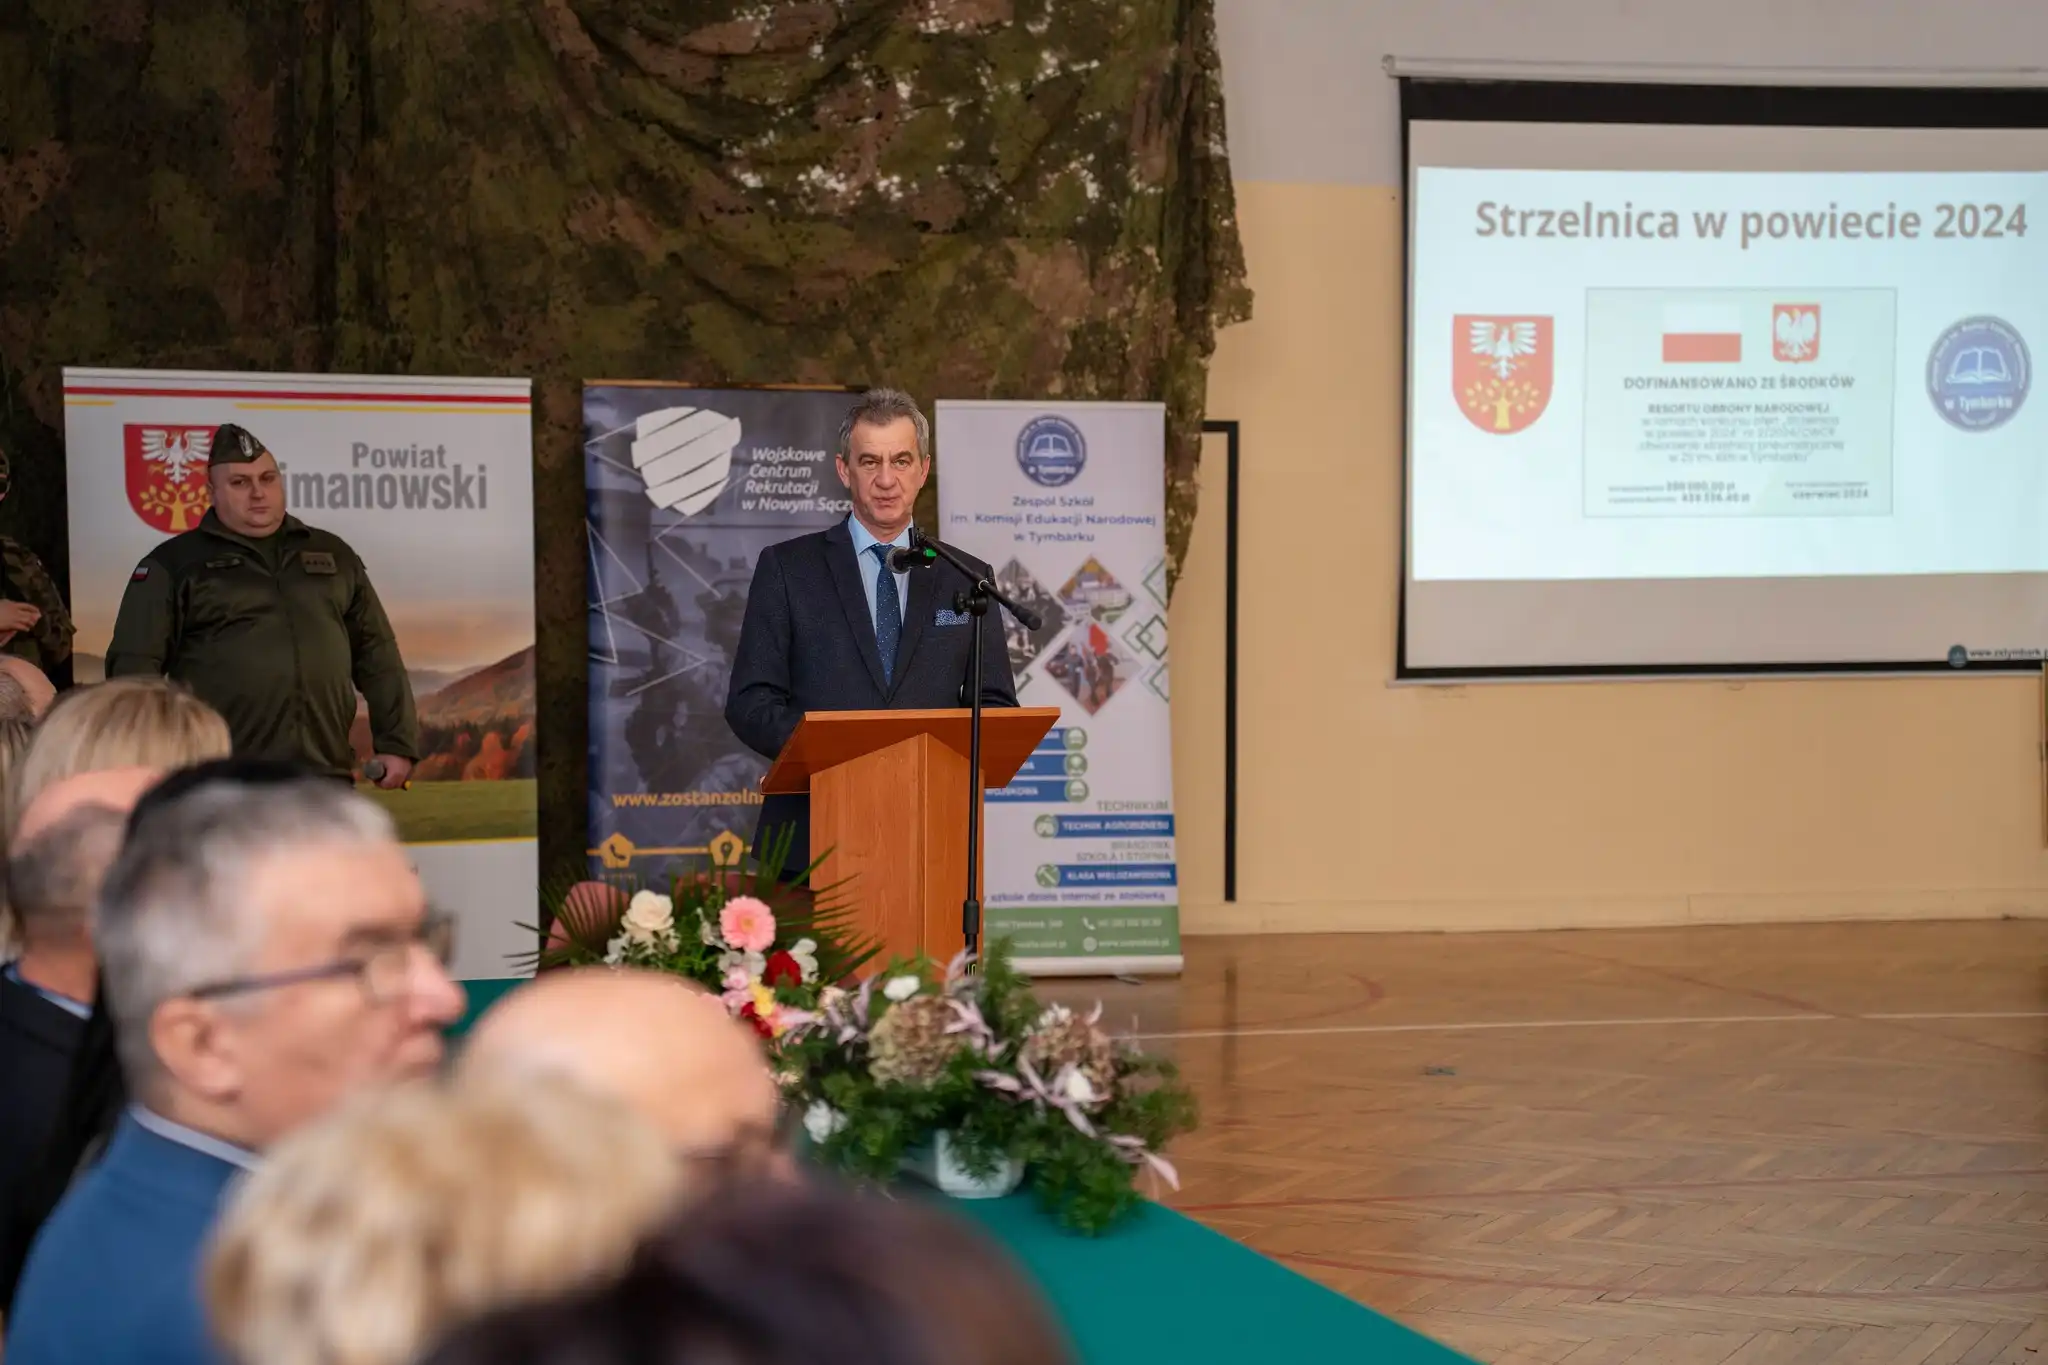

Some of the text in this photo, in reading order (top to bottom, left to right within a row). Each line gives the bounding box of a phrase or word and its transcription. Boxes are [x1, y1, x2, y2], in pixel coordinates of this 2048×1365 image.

[1475, 200, 2029, 250] Strzelnica w powiecie 2024
[1624, 374, 1856, 390] DOFINANSOWANO ZE ŚRODKÓW
[351, 442, 448, 469] Powiat
[752, 446, 827, 464] Wojskowe
[749, 464, 812, 478] Centrum
[280, 462, 488, 510] imanowski
[745, 479, 819, 497] Rekrutacji
[741, 501, 756, 511] w
[758, 497, 814, 514] Nowym
[1013, 496, 1095, 508] Zespół Szkół
[975, 513, 1023, 526] Komisji
[1026, 514, 1082, 526] Edukacji
[1086, 514, 1156, 526] Narodowej
[1014, 531, 1095, 544] w Tymbarku
[1096, 800, 1169, 812] TECHNIKUM
